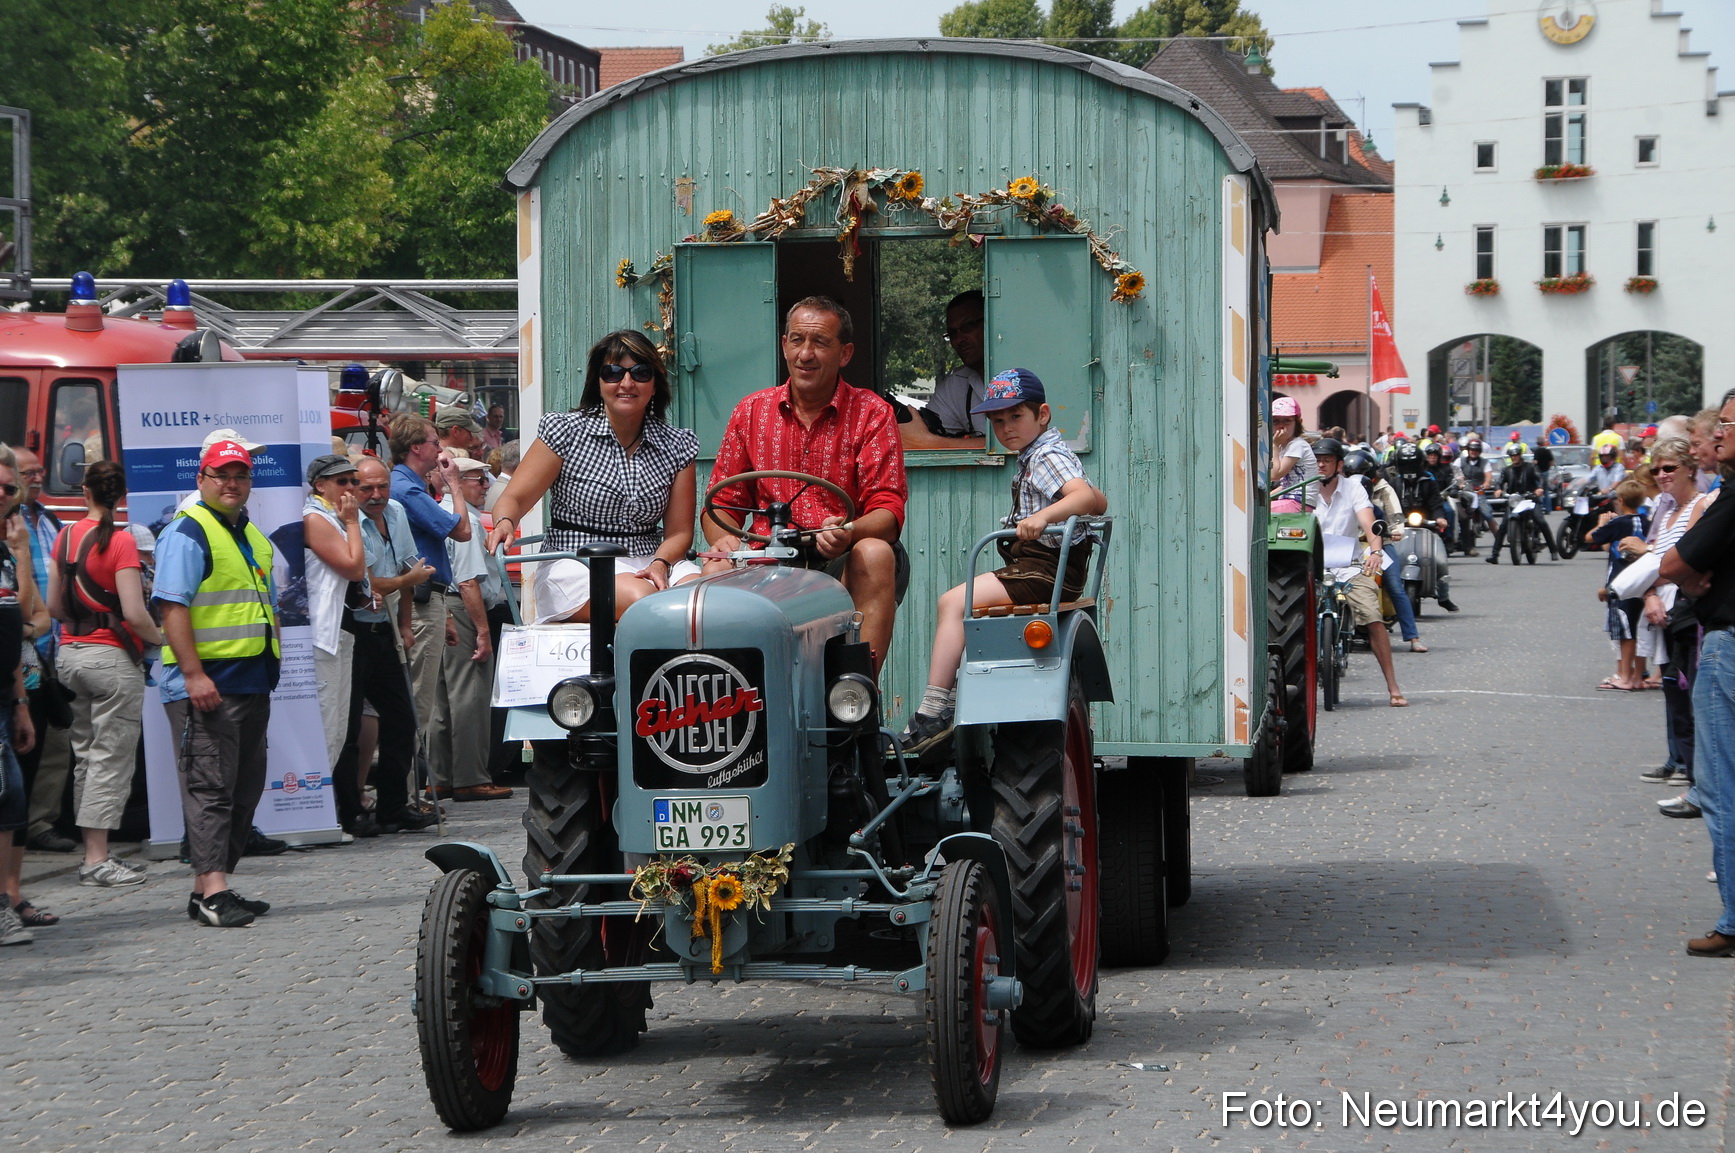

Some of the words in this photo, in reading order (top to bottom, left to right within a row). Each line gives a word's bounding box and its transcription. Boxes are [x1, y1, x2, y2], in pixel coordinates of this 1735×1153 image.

[141, 411, 200, 428] KOLLER
[213, 412, 284, 426] Schwemmer
[219, 450, 244, 458] DEKRA
[175, 458, 201, 468] Histor
[251, 456, 277, 466] obile,
[177, 471, 195, 479] eine
[257, 467, 287, 478] Antrieb.
[636, 687, 764, 738] Eicher
[659, 813, 666, 821] D
[672, 801, 703, 824] NM
[660, 826, 690, 848] GA
[701, 824, 746, 847] 993
